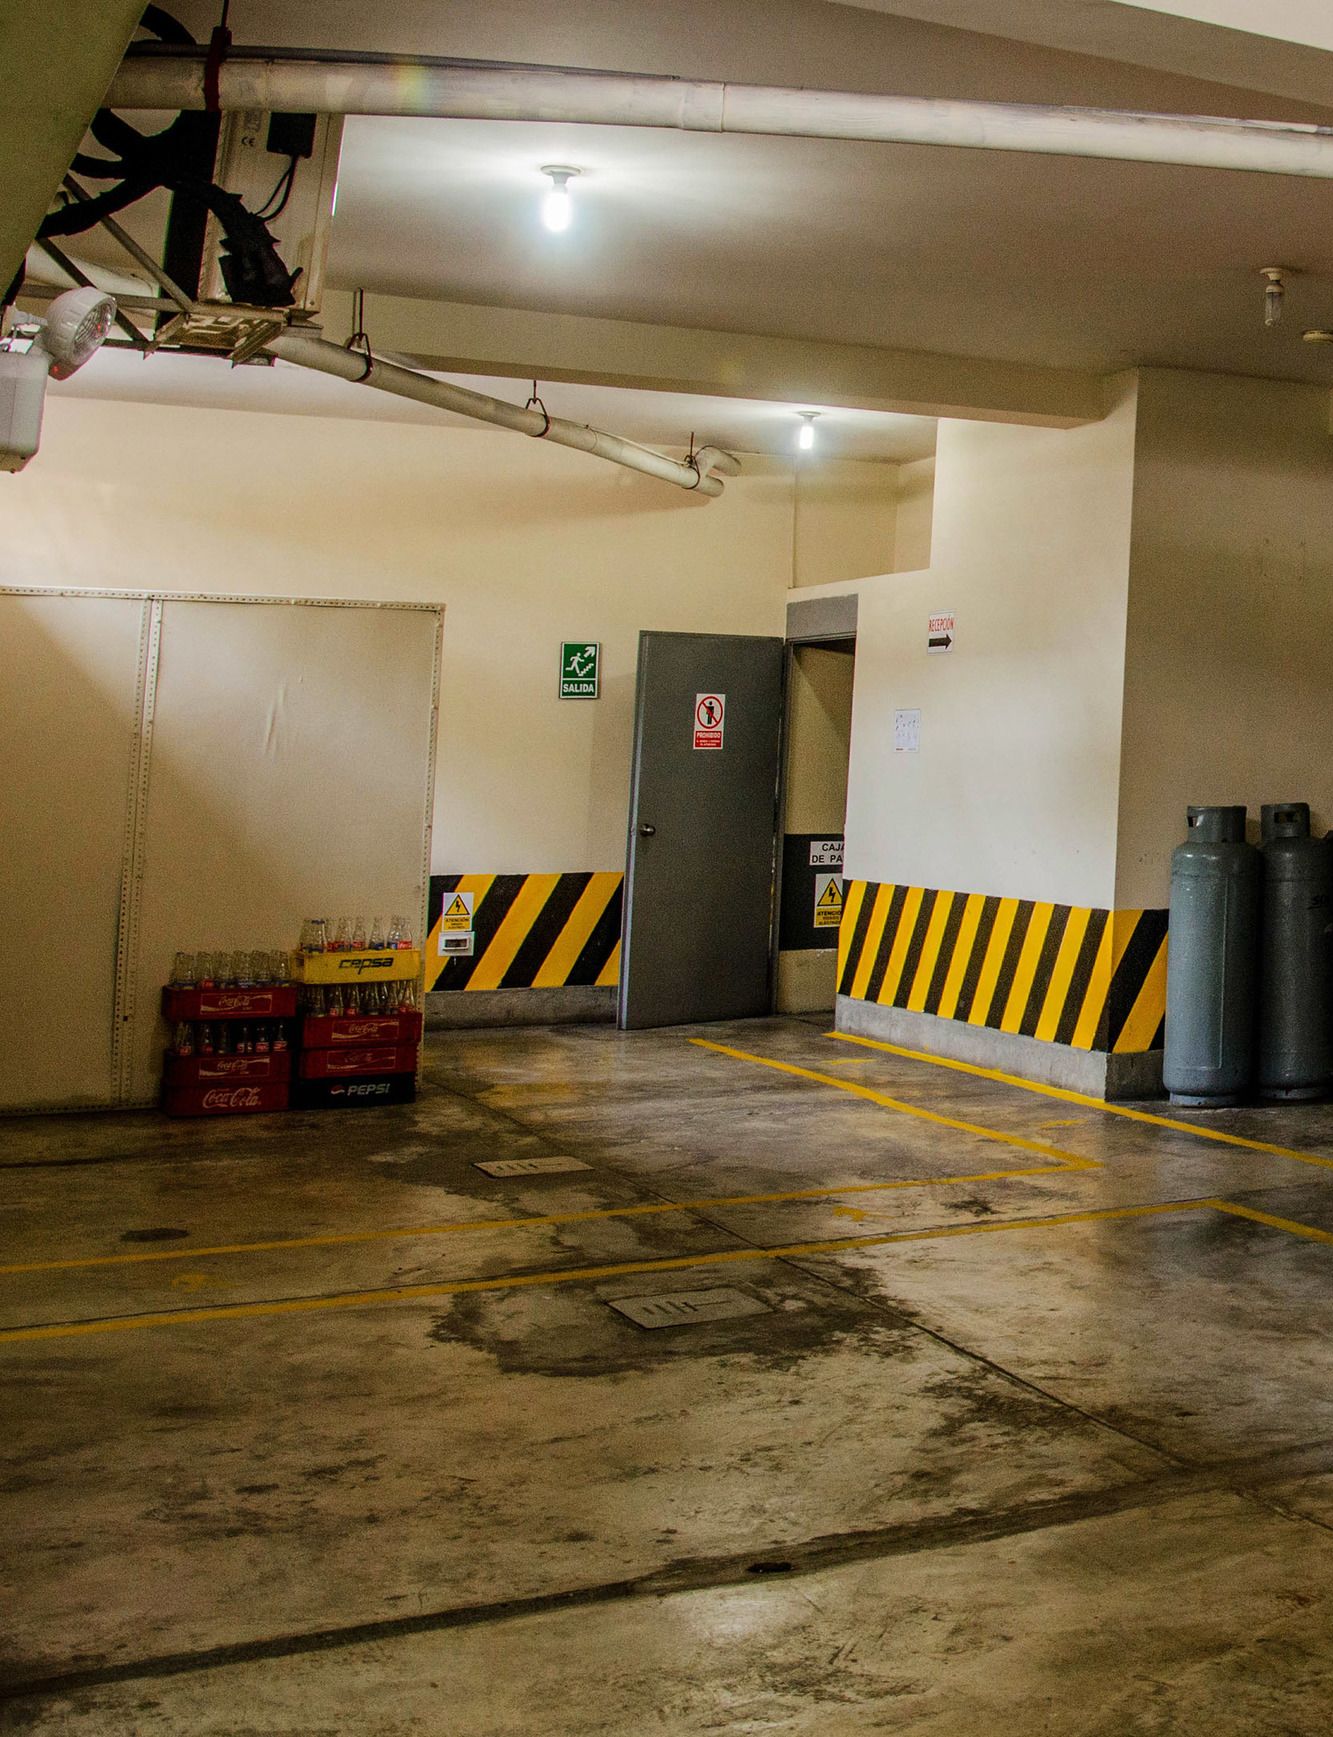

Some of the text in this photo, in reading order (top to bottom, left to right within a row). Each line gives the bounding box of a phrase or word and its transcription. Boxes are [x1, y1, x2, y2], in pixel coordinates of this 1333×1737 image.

[562, 683, 595, 693] SALIDA
[811, 855, 843, 863] DE PA
[339, 957, 394, 975] cepsa
[347, 1083, 391, 1096] PEPSI
